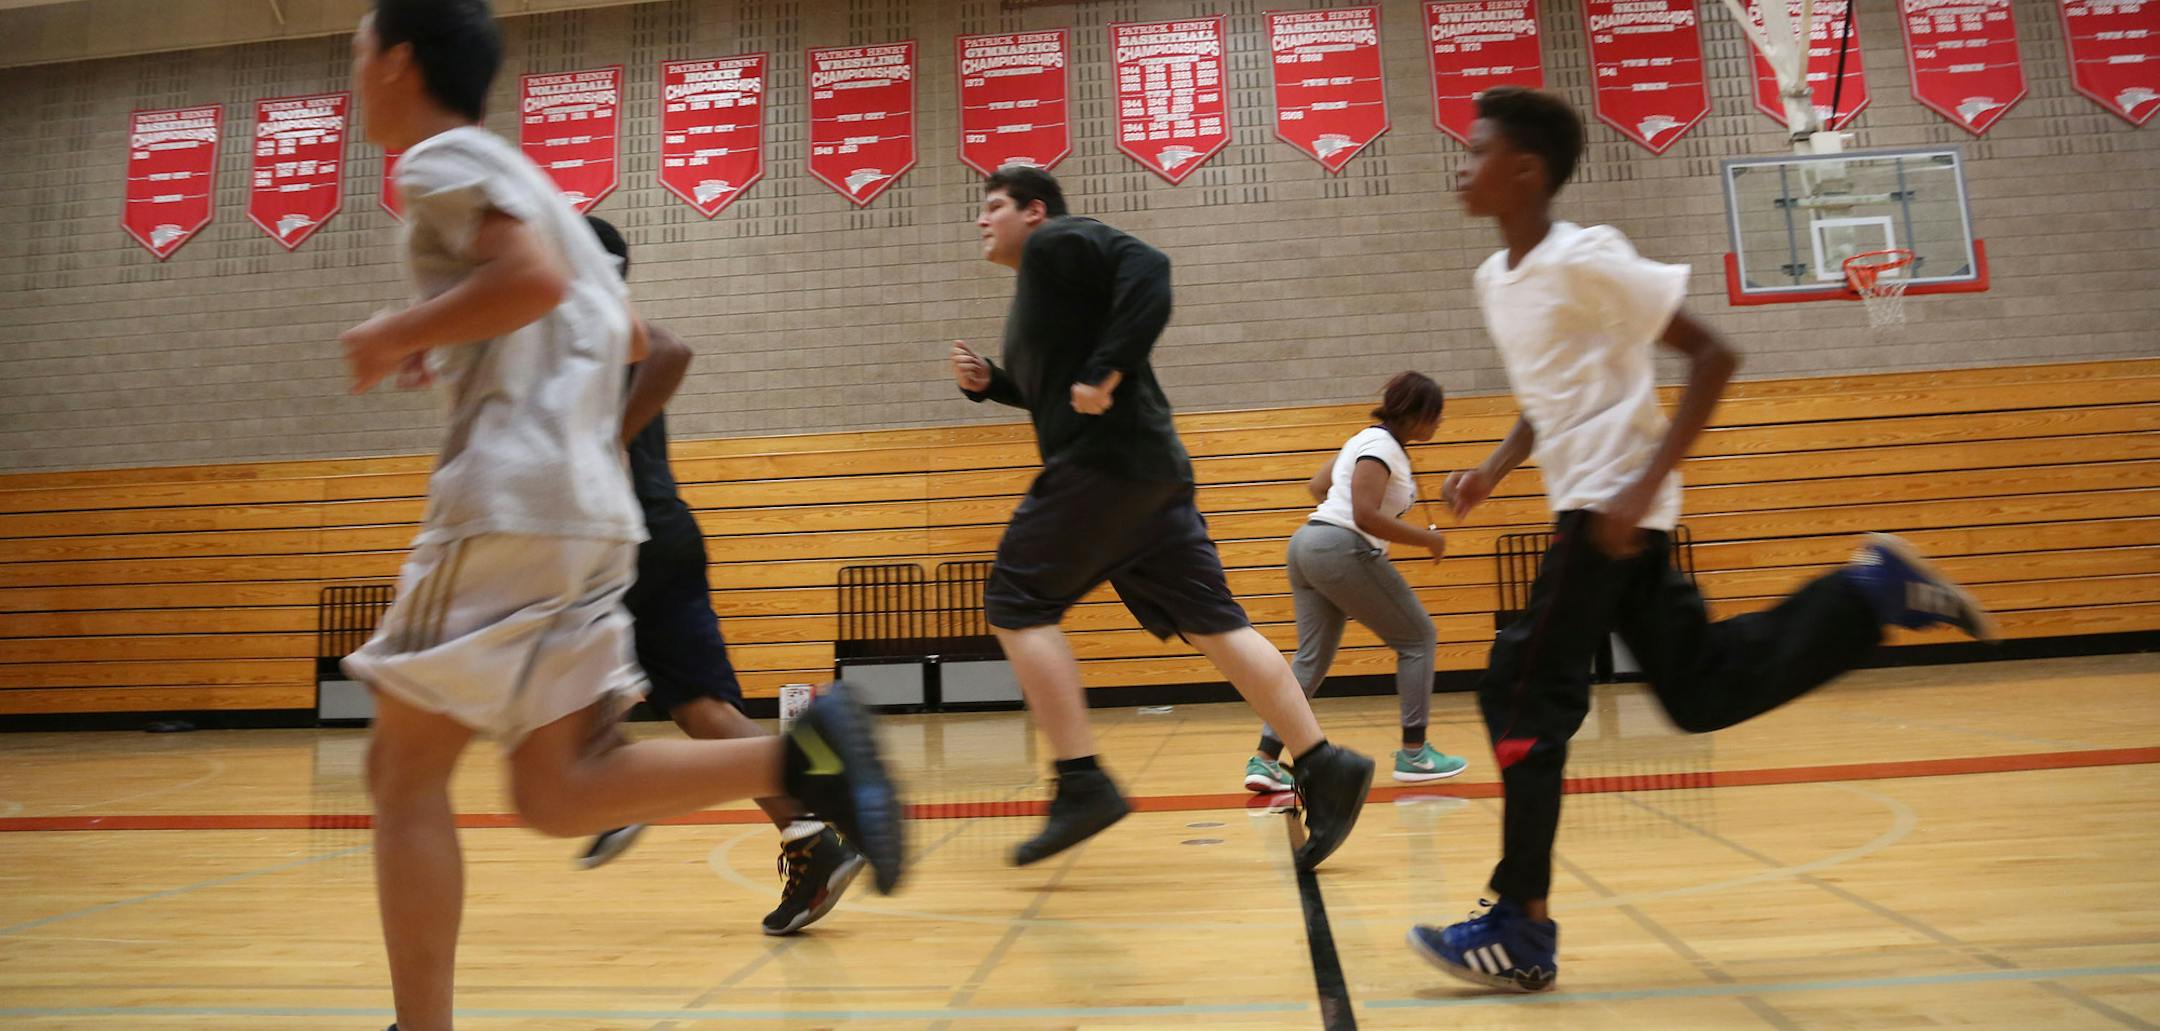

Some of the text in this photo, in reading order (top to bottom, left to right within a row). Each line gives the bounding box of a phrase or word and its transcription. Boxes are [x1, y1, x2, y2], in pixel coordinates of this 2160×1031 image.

[1432, 0, 1529, 13] PATRICK HENRY
[1612, 1, 1668, 13] SKIING
[1273, 9, 1371, 25] PATRICK HENRY
[1439, 9, 1525, 24] SWIMMING
[1590, 9, 1695, 31] CHAMPIONSHIPS
[1119, 20, 1216, 36] PATRICK HENRY
[1273, 19, 1373, 35] BASKETBALL
[1431, 19, 1536, 42] CHAMPIONSHIPS
[964, 32, 1060, 48] PATRICK HENRY
[1119, 30, 1218, 47] BASKETBALL
[1272, 29, 1376, 51] CHAMPIONSHIPS
[814, 45, 908, 60] PATRICK HENRY
[965, 42, 1060, 58] GYMNASTICS
[1117, 41, 1220, 64] CHAMPIONSHIPS
[668, 58, 759, 74] PATRICK HENRY
[818, 54, 904, 71] WRESTLING
[962, 52, 1064, 75] CHAMPIONSHIPS
[527, 71, 615, 87] PATRICK HENRY
[684, 68, 743, 83] HOCKEY
[812, 65, 911, 88] CHAMPIONSHIPS
[528, 80, 614, 96] VOLLEYBALL
[665, 77, 761, 100] CHAMPIONSHIPS
[525, 90, 616, 113] CHAMPIONSHIPS
